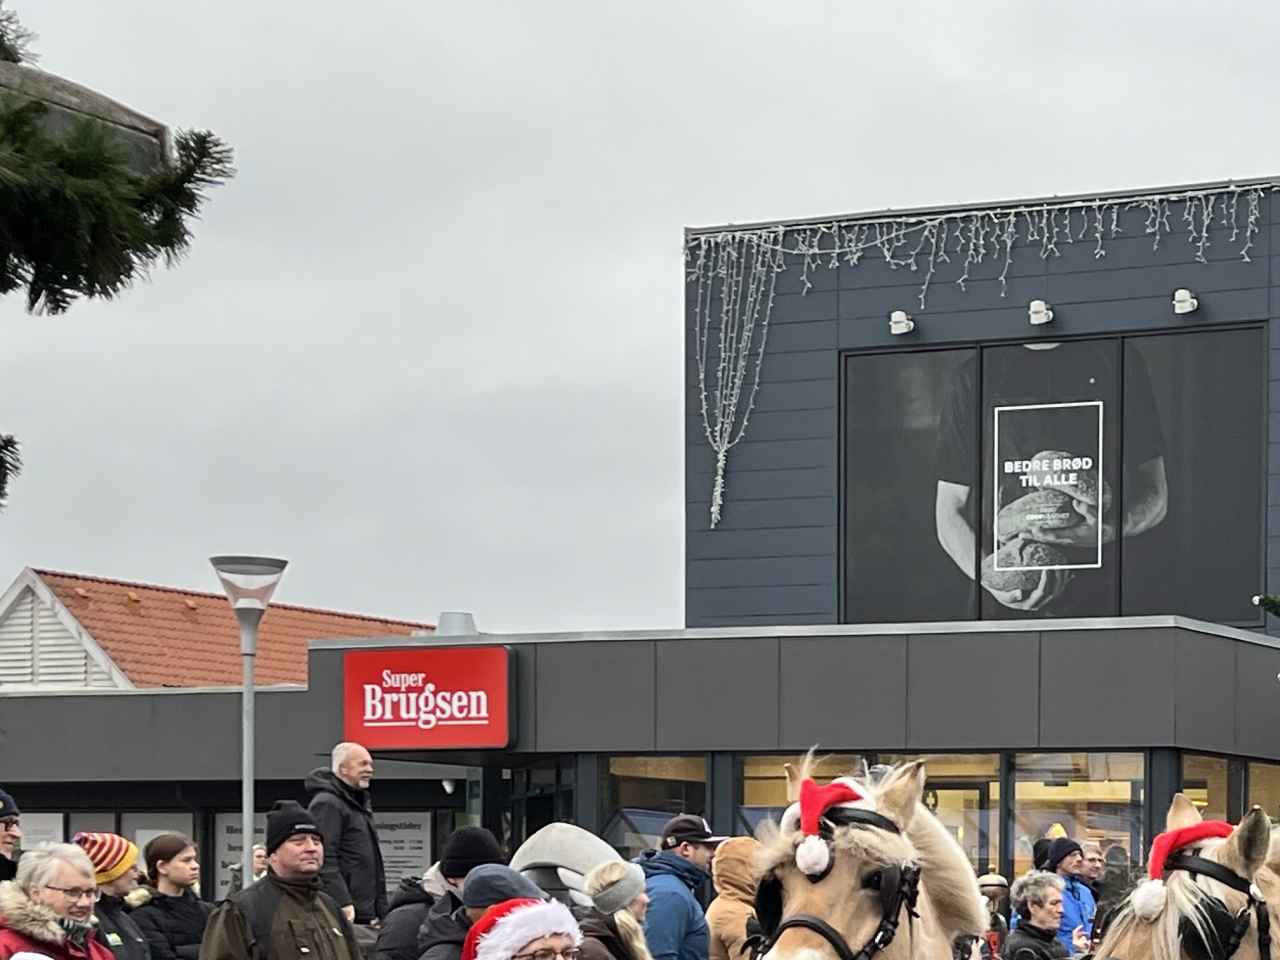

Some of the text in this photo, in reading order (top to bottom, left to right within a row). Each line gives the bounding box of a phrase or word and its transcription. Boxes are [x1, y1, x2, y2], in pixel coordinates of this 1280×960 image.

[1004, 457, 1093, 473] BEDRE BRØD
[1019, 473, 1078, 487] TIL ALLE
[382, 669, 426, 692] Super
[363, 682, 489, 730] Brugsen
